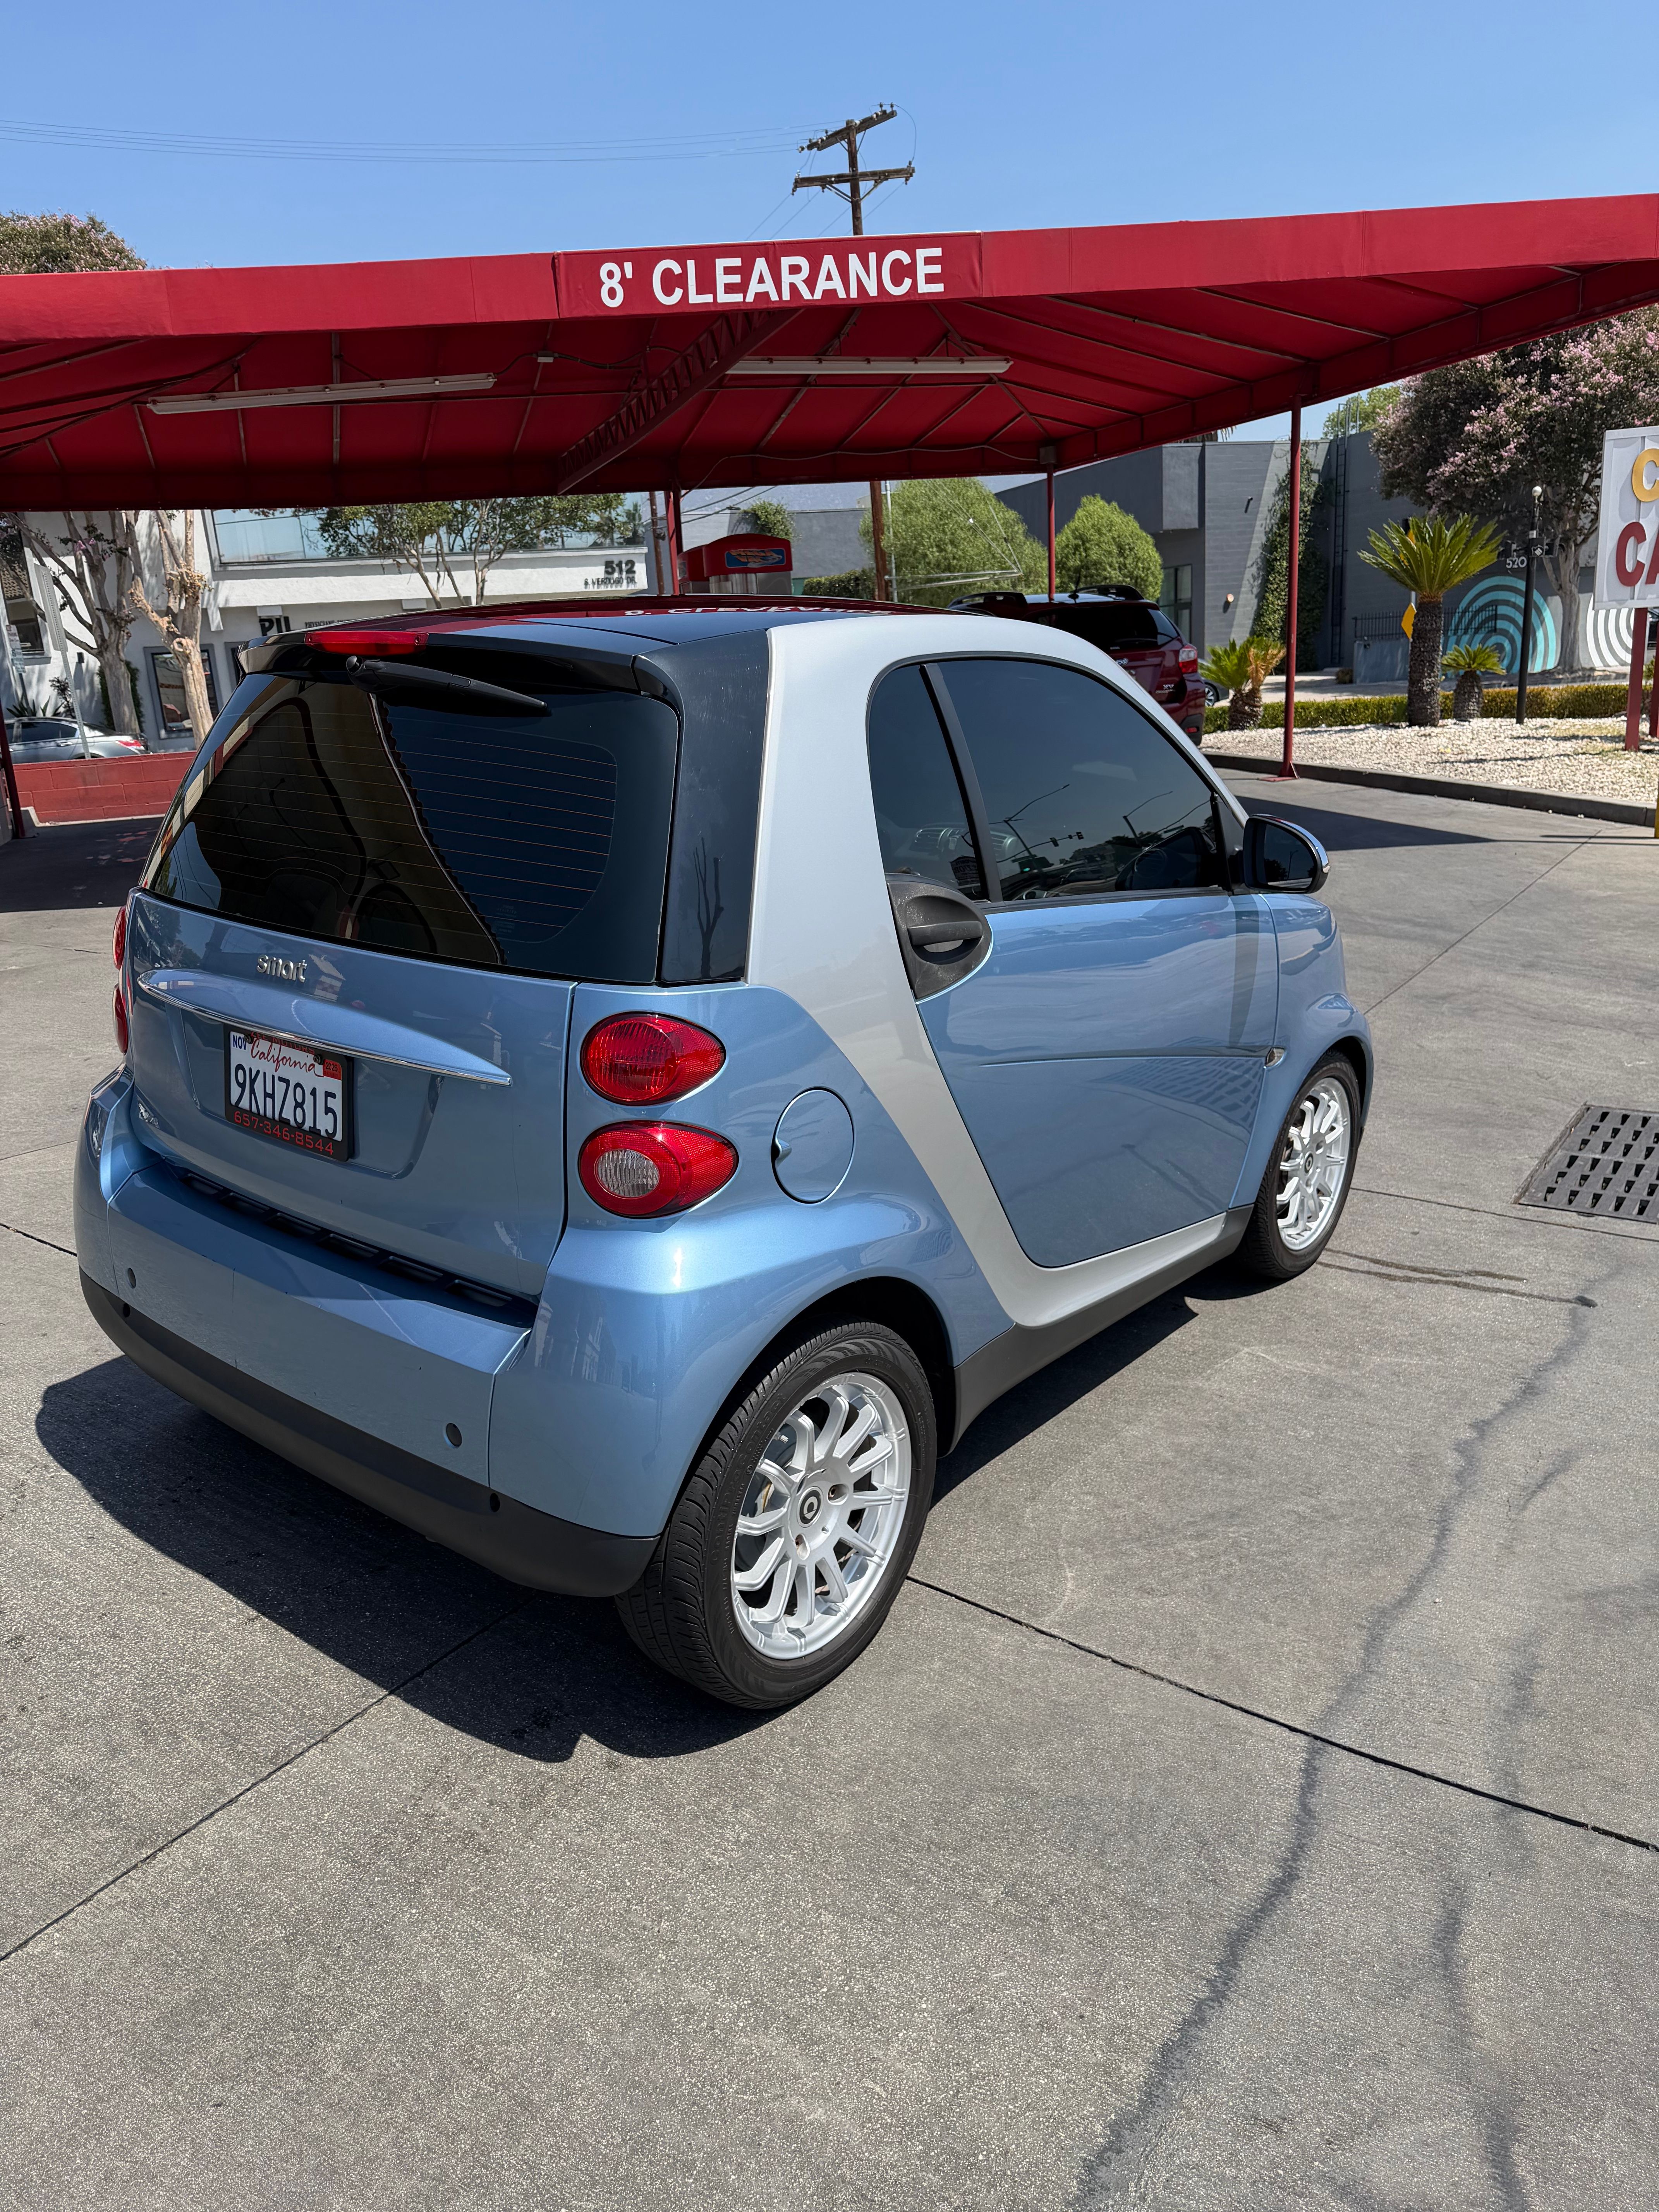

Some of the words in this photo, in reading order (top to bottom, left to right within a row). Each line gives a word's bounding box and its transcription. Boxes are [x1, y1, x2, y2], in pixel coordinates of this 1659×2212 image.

[600, 262, 633, 308] 8'
[652, 247, 945, 306] CLEARANCE
[605, 560, 636, 575] 512
[1506, 556, 1527, 568] 520
[592, 576, 623, 586] VERDUGO
[257, 954, 307, 983] smart
[233, 1034, 247, 1050] NOV
[251, 1038, 325, 1077] California
[326, 1062, 338, 1072] 2026
[234, 1063, 337, 1139] 9KHZ815
[234, 1111, 334, 1155] 657-346-8544
